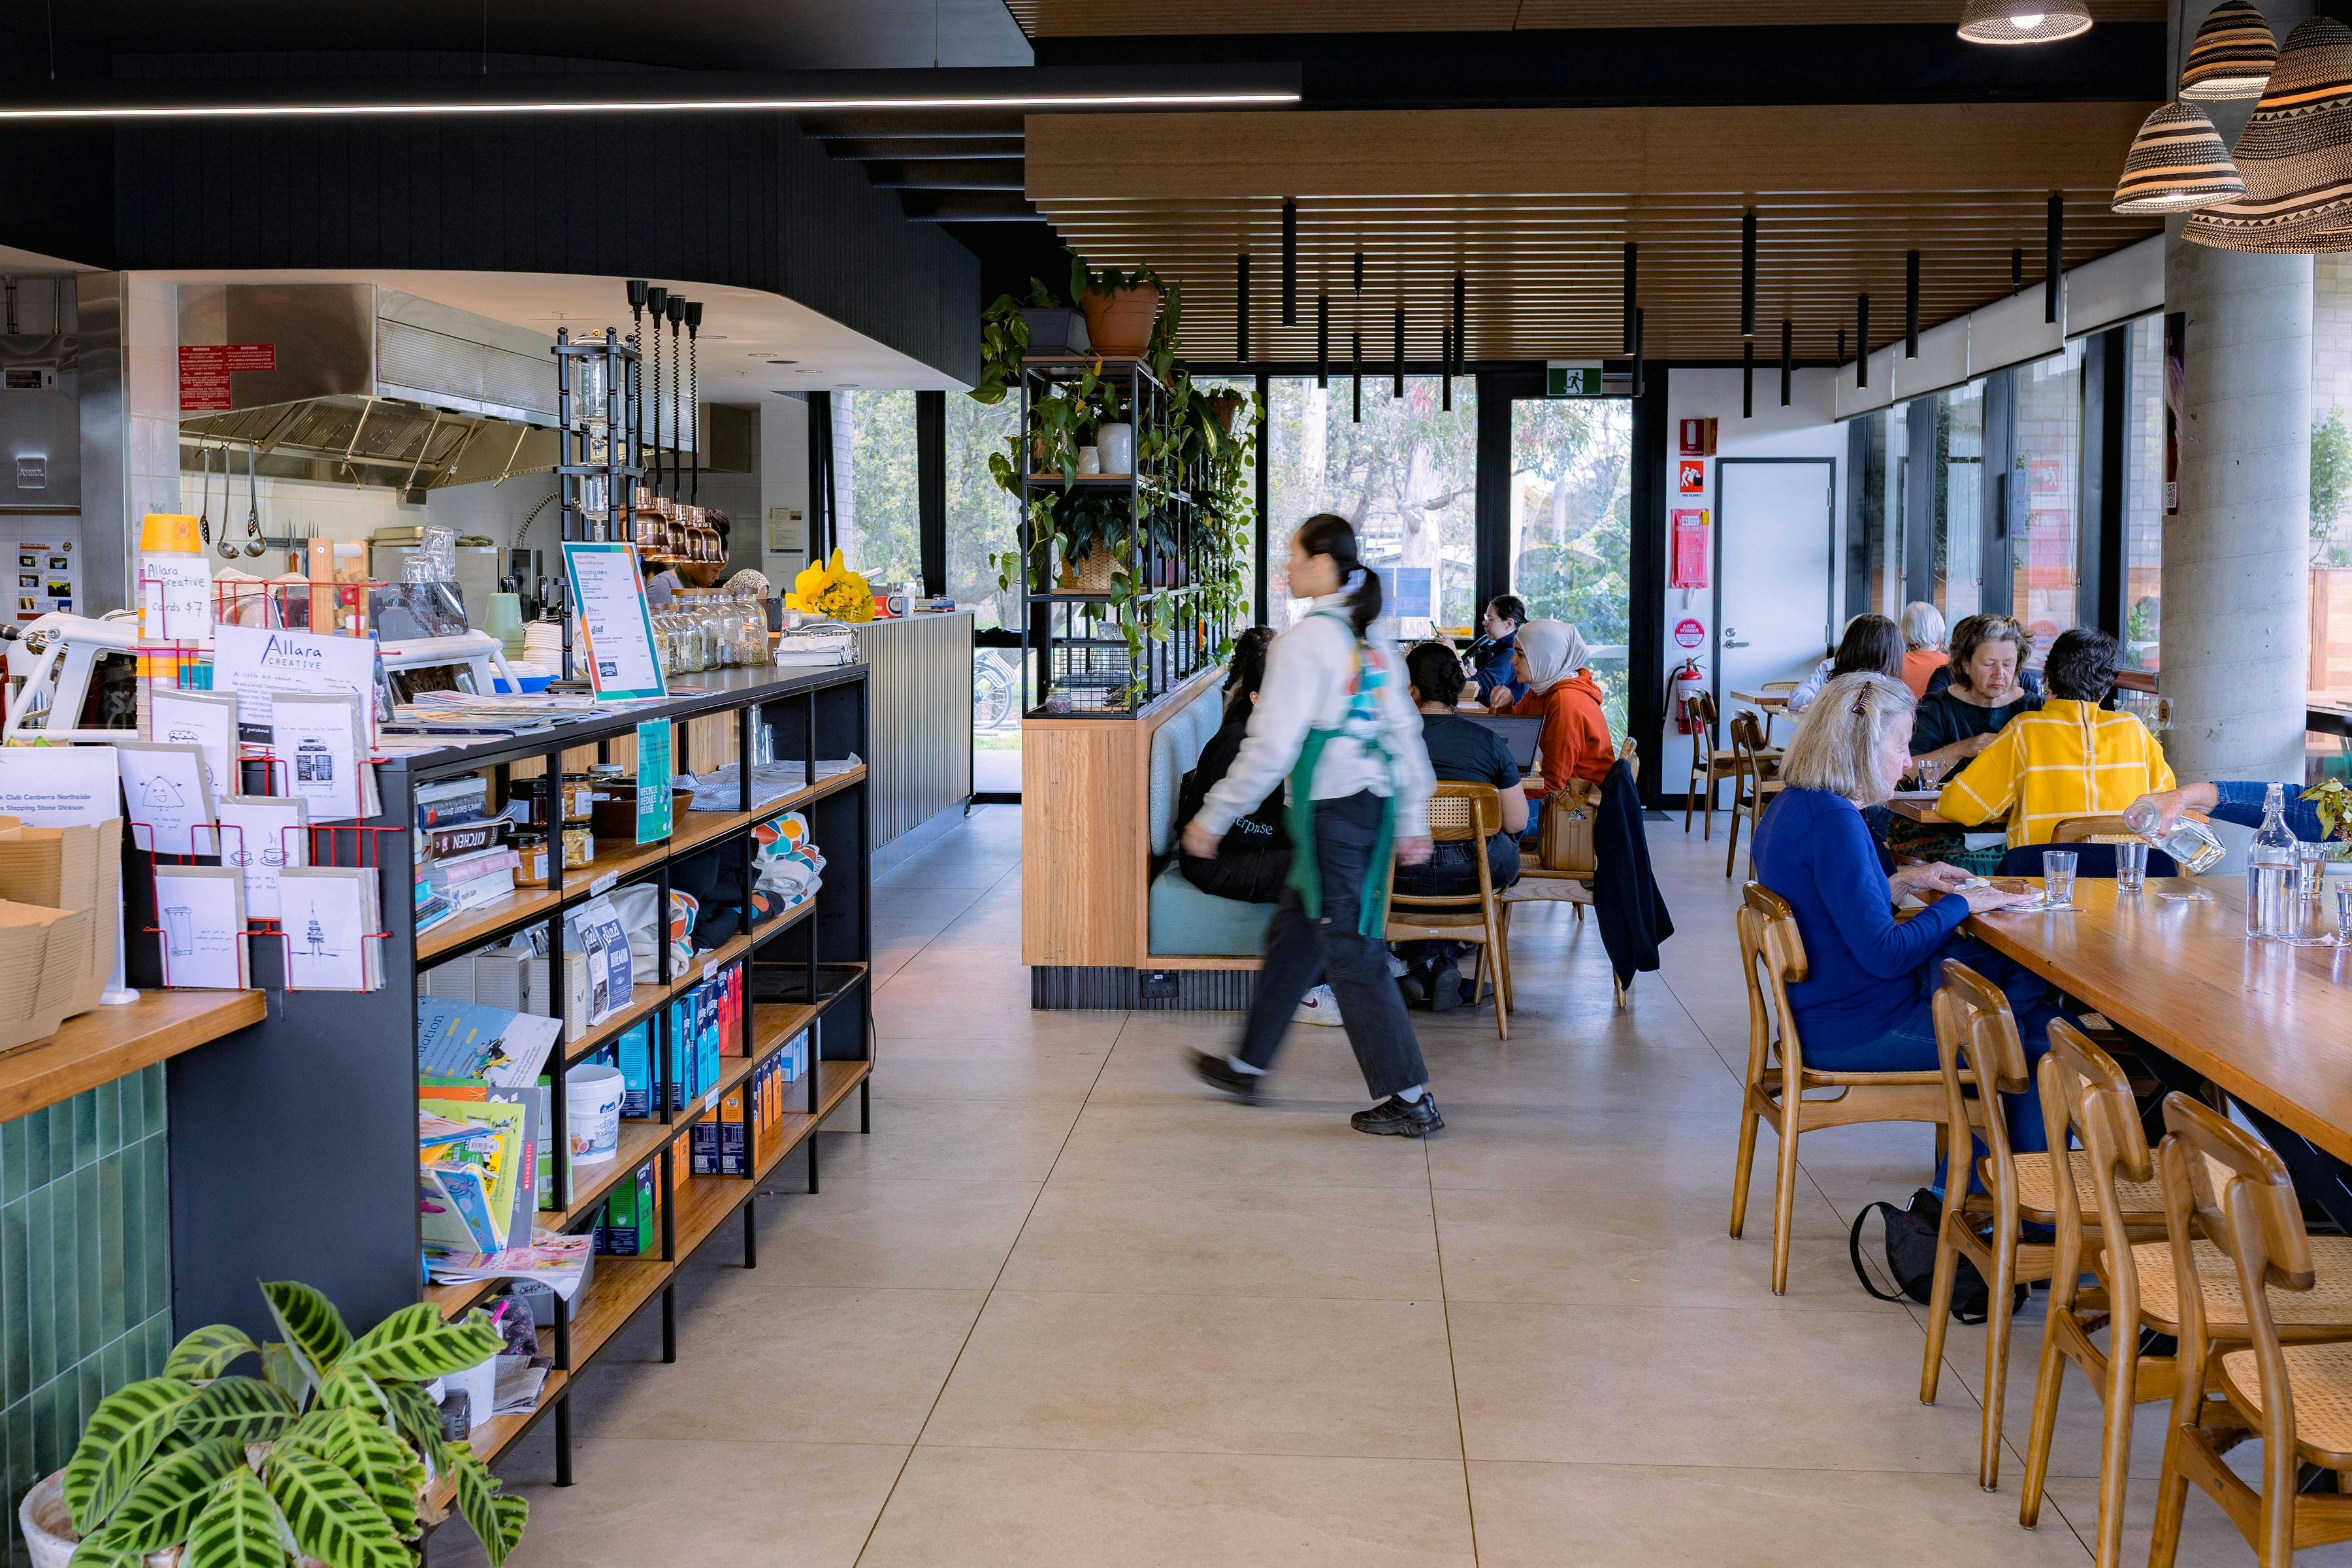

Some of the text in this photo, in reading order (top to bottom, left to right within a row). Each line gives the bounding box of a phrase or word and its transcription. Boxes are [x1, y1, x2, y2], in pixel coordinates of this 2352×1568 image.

[148, 563, 178, 578] Allara
[261, 634, 322, 665] Allara
[269, 657, 321, 669] CREATIVE
[2161, 709, 2168, 719] 51
[640, 785, 658, 796] RECYCLE
[640, 794, 657, 806] REDUCE
[640, 804, 654, 815] REUSE
[452, 831, 486, 849] KITCHEN
